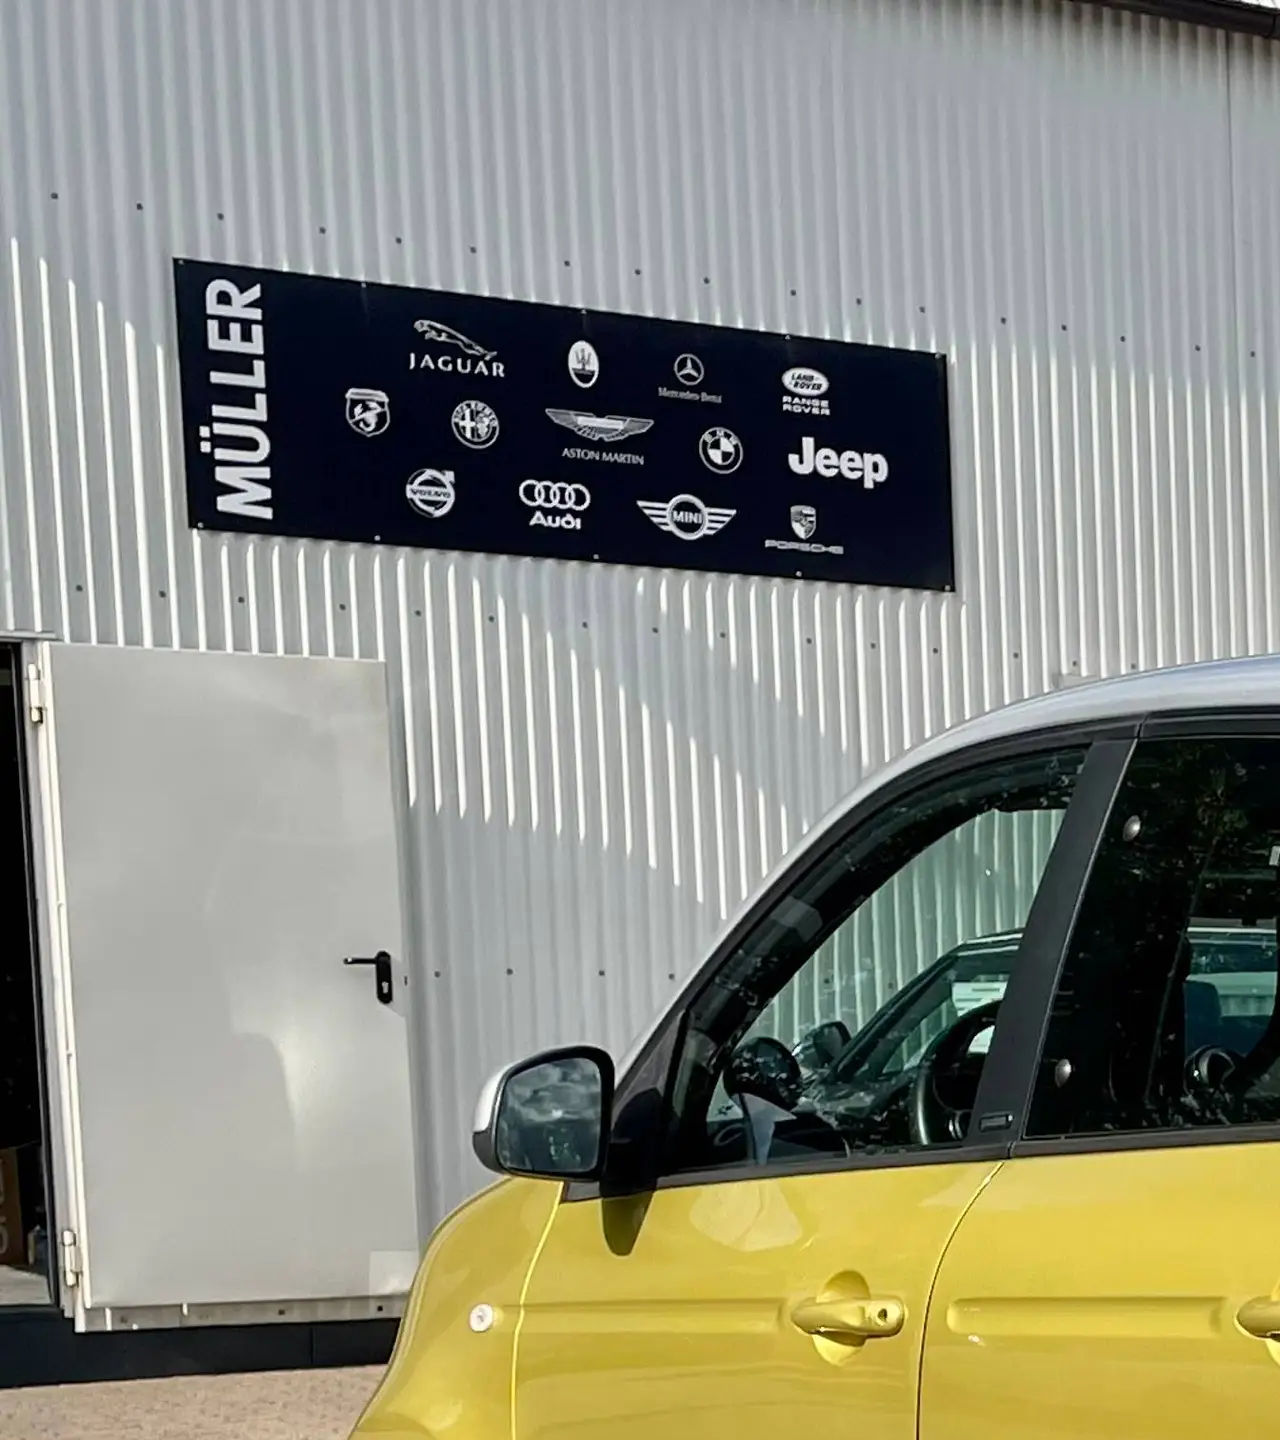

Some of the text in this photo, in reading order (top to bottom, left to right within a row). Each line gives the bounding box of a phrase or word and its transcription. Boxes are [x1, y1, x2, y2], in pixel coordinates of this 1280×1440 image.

[409, 352, 506, 378] JAGUAR
[200, 278, 274, 520] MÜLLER
[782, 395, 829, 408] RANGE
[782, 403, 831, 416] ROVER
[561, 447, 645, 465] ASTON MARTIN
[787, 436, 889, 489] Jeep
[529, 510, 582, 530] Audi
[671, 510, 703, 525] MINI
